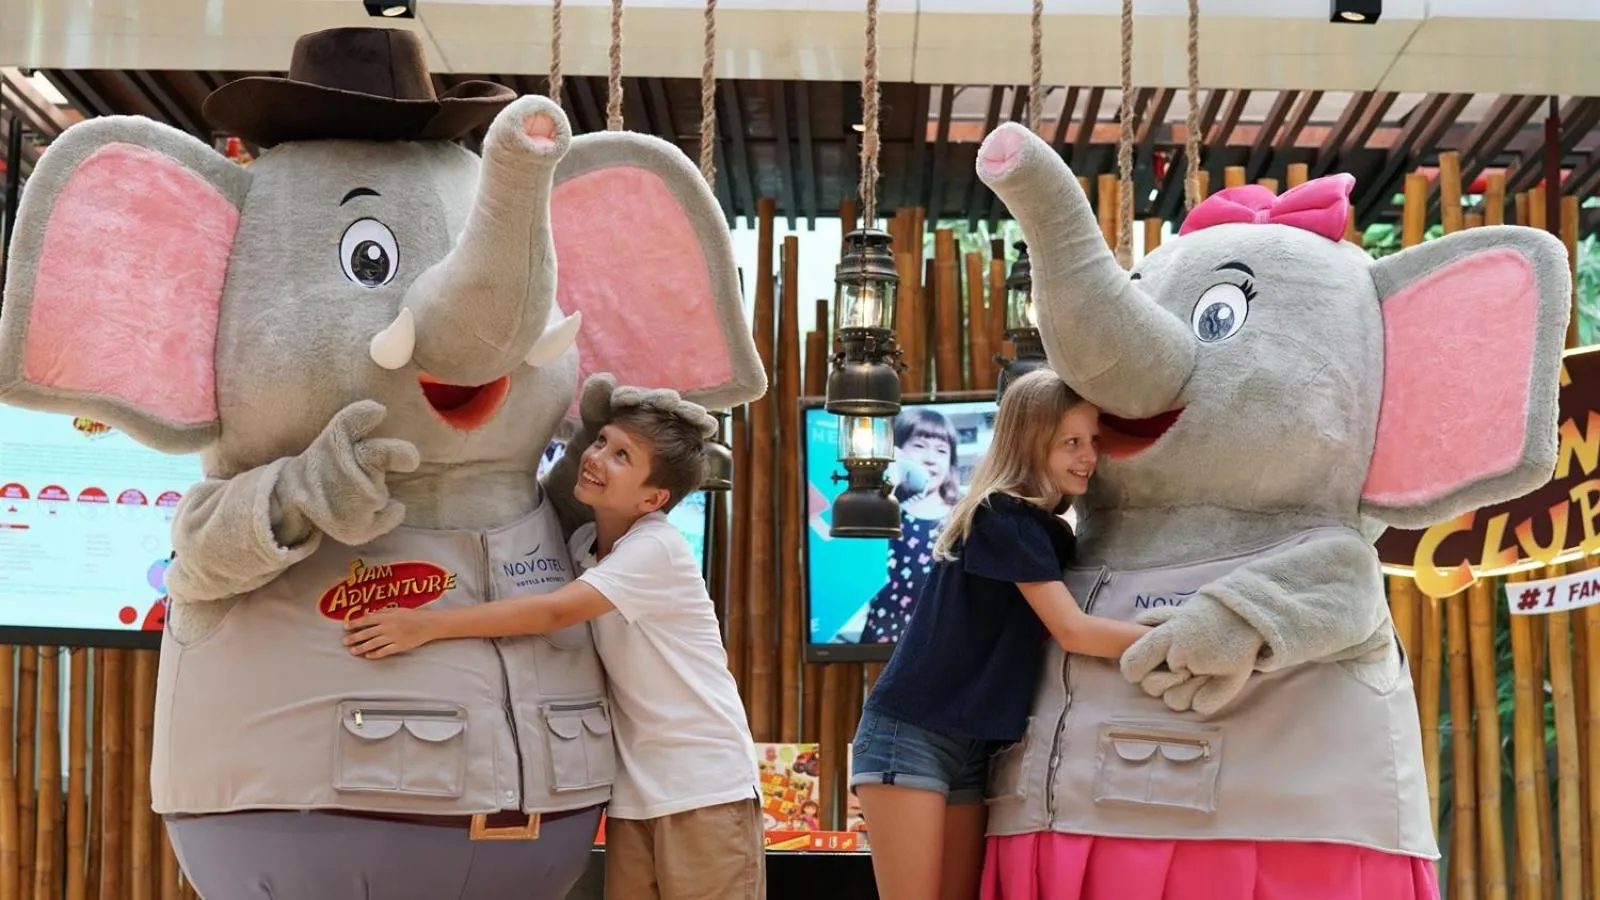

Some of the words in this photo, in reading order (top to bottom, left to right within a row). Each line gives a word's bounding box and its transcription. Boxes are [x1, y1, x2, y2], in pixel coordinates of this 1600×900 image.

[345, 558, 393, 587] SIAM
[503, 559, 566, 577] NOVOTEL
[327, 572, 457, 613] ADVENTURE
[1135, 594, 1183, 608] NOV
